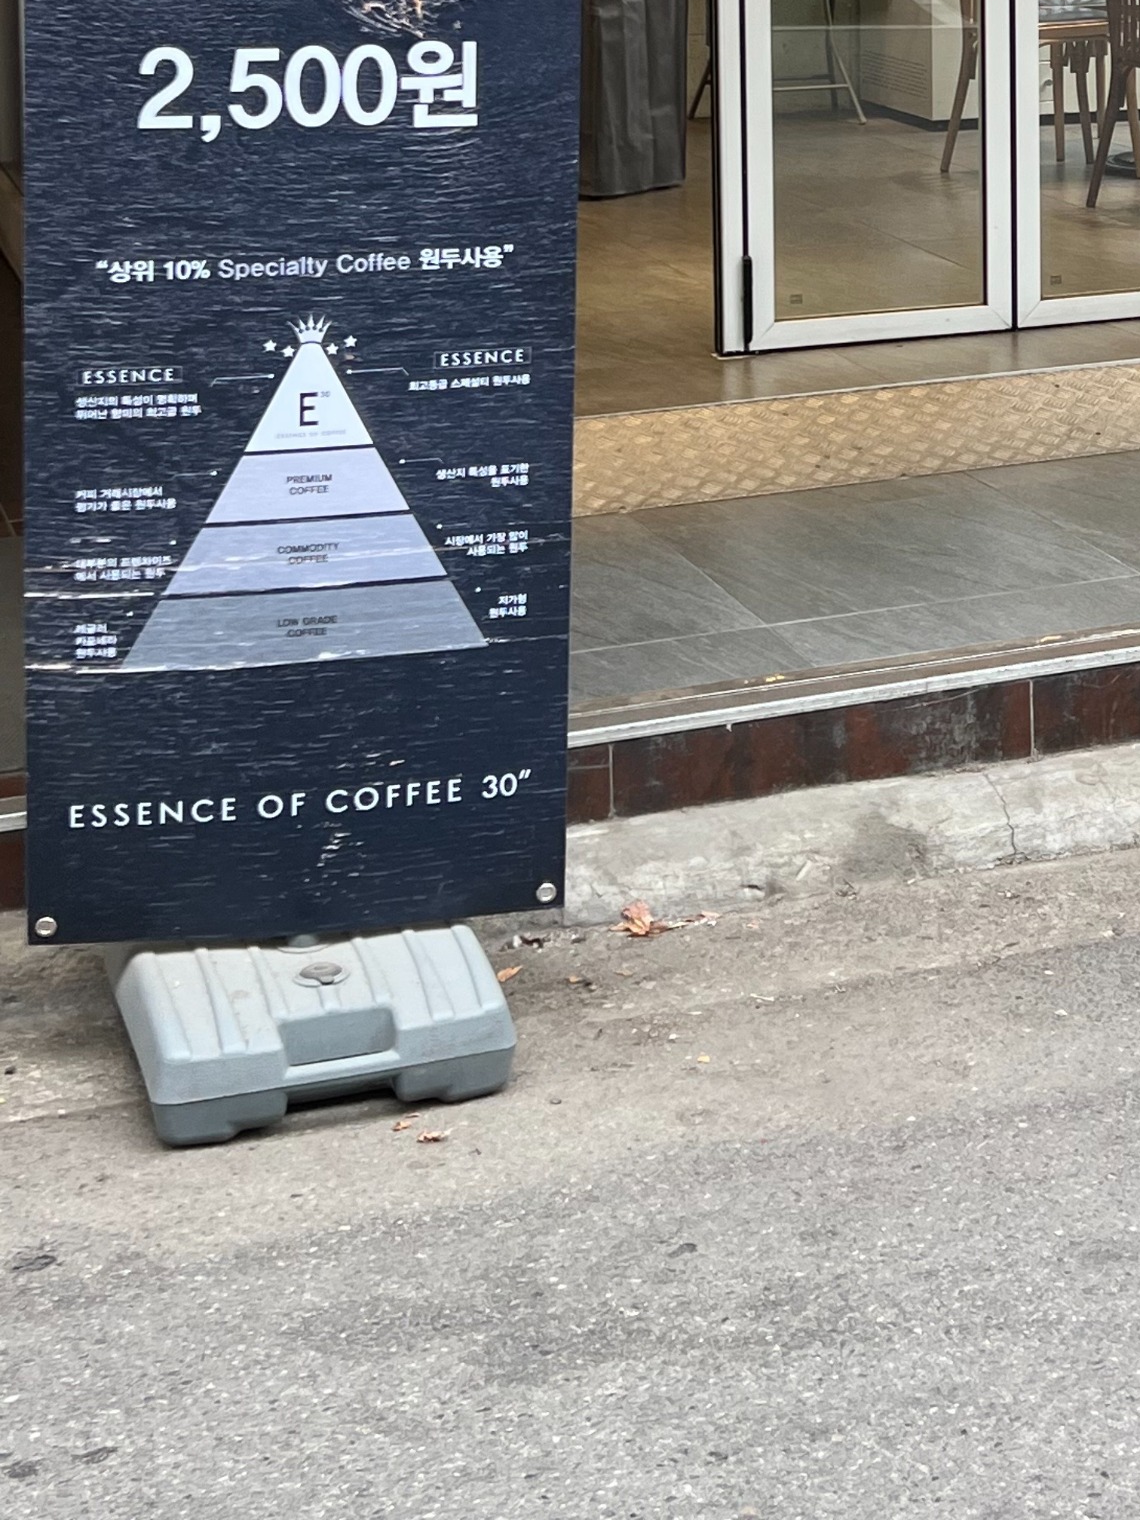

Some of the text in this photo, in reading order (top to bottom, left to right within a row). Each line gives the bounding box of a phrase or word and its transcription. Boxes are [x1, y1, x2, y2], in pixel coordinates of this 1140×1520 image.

[137, 39, 479, 144] 2,500원
[163, 259, 211, 282] 10%
[218, 257, 328, 281] Specialty
[336, 253, 411, 275] Coffee
[440, 348, 525, 367] ESSENCE
[82, 368, 175, 385] ESSENCE
[492, 373, 531, 387] 원두사용
[299, 391, 319, 427] E
[286, 473, 333, 484] PREMIUM
[436, 467, 466, 481] 생산지
[490, 475, 529, 488] 원두사용
[100, 486, 163, 499] 거래시장에서
[289, 484, 330, 496] COFFEE
[135, 497, 177, 510] 원두사용
[444, 533, 483, 547] 시장에서
[486, 531, 506, 544] 가장
[277, 542, 340, 555] COMMODITY
[466, 544, 505, 557] 사용되는
[288, 553, 329, 565] COFFEE
[302, 615, 338, 626] GRADE
[287, 627, 328, 638] COFFEE
[69, 796, 237, 829] ESSENCE
[257, 791, 307, 820] OF
[325, 777, 464, 814] COFFEE
